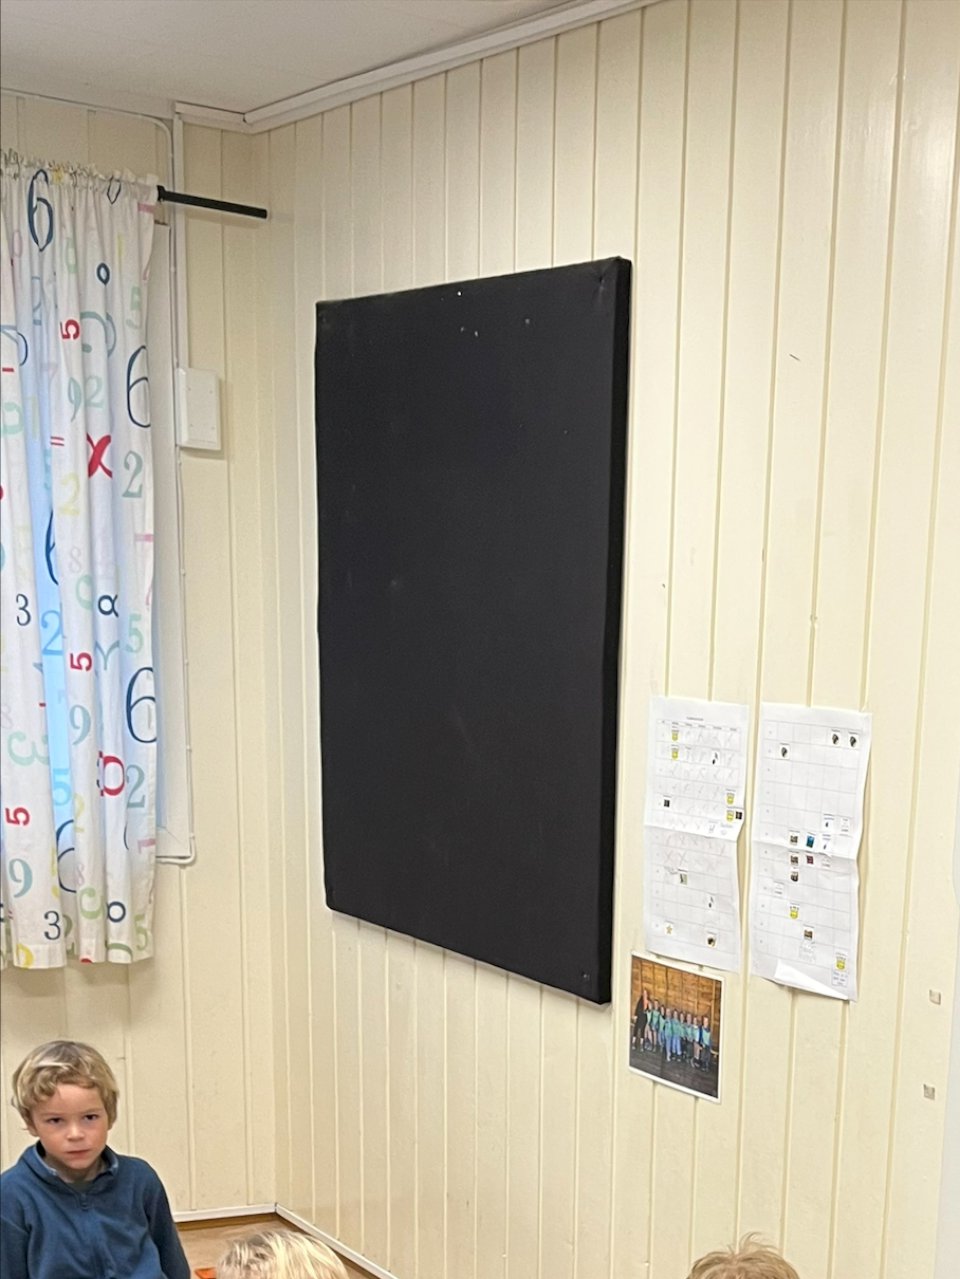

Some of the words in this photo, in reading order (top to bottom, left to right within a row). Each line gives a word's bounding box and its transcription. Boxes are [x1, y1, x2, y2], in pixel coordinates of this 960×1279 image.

[28, 169, 54, 252] 6
[60, 319, 81, 341] 5
[122, 450, 144, 498] 2
[16, 593, 31, 627] 3
[41, 609, 63, 656] 2
[70, 652, 92, 671] 5
[69, 704, 91, 746] 9
[126, 666, 157, 744] 6
[126, 763, 146, 809] 2
[5, 806, 31, 827] 5
[8, 858, 33, 898] 9
[43, 910, 62, 941] 3
